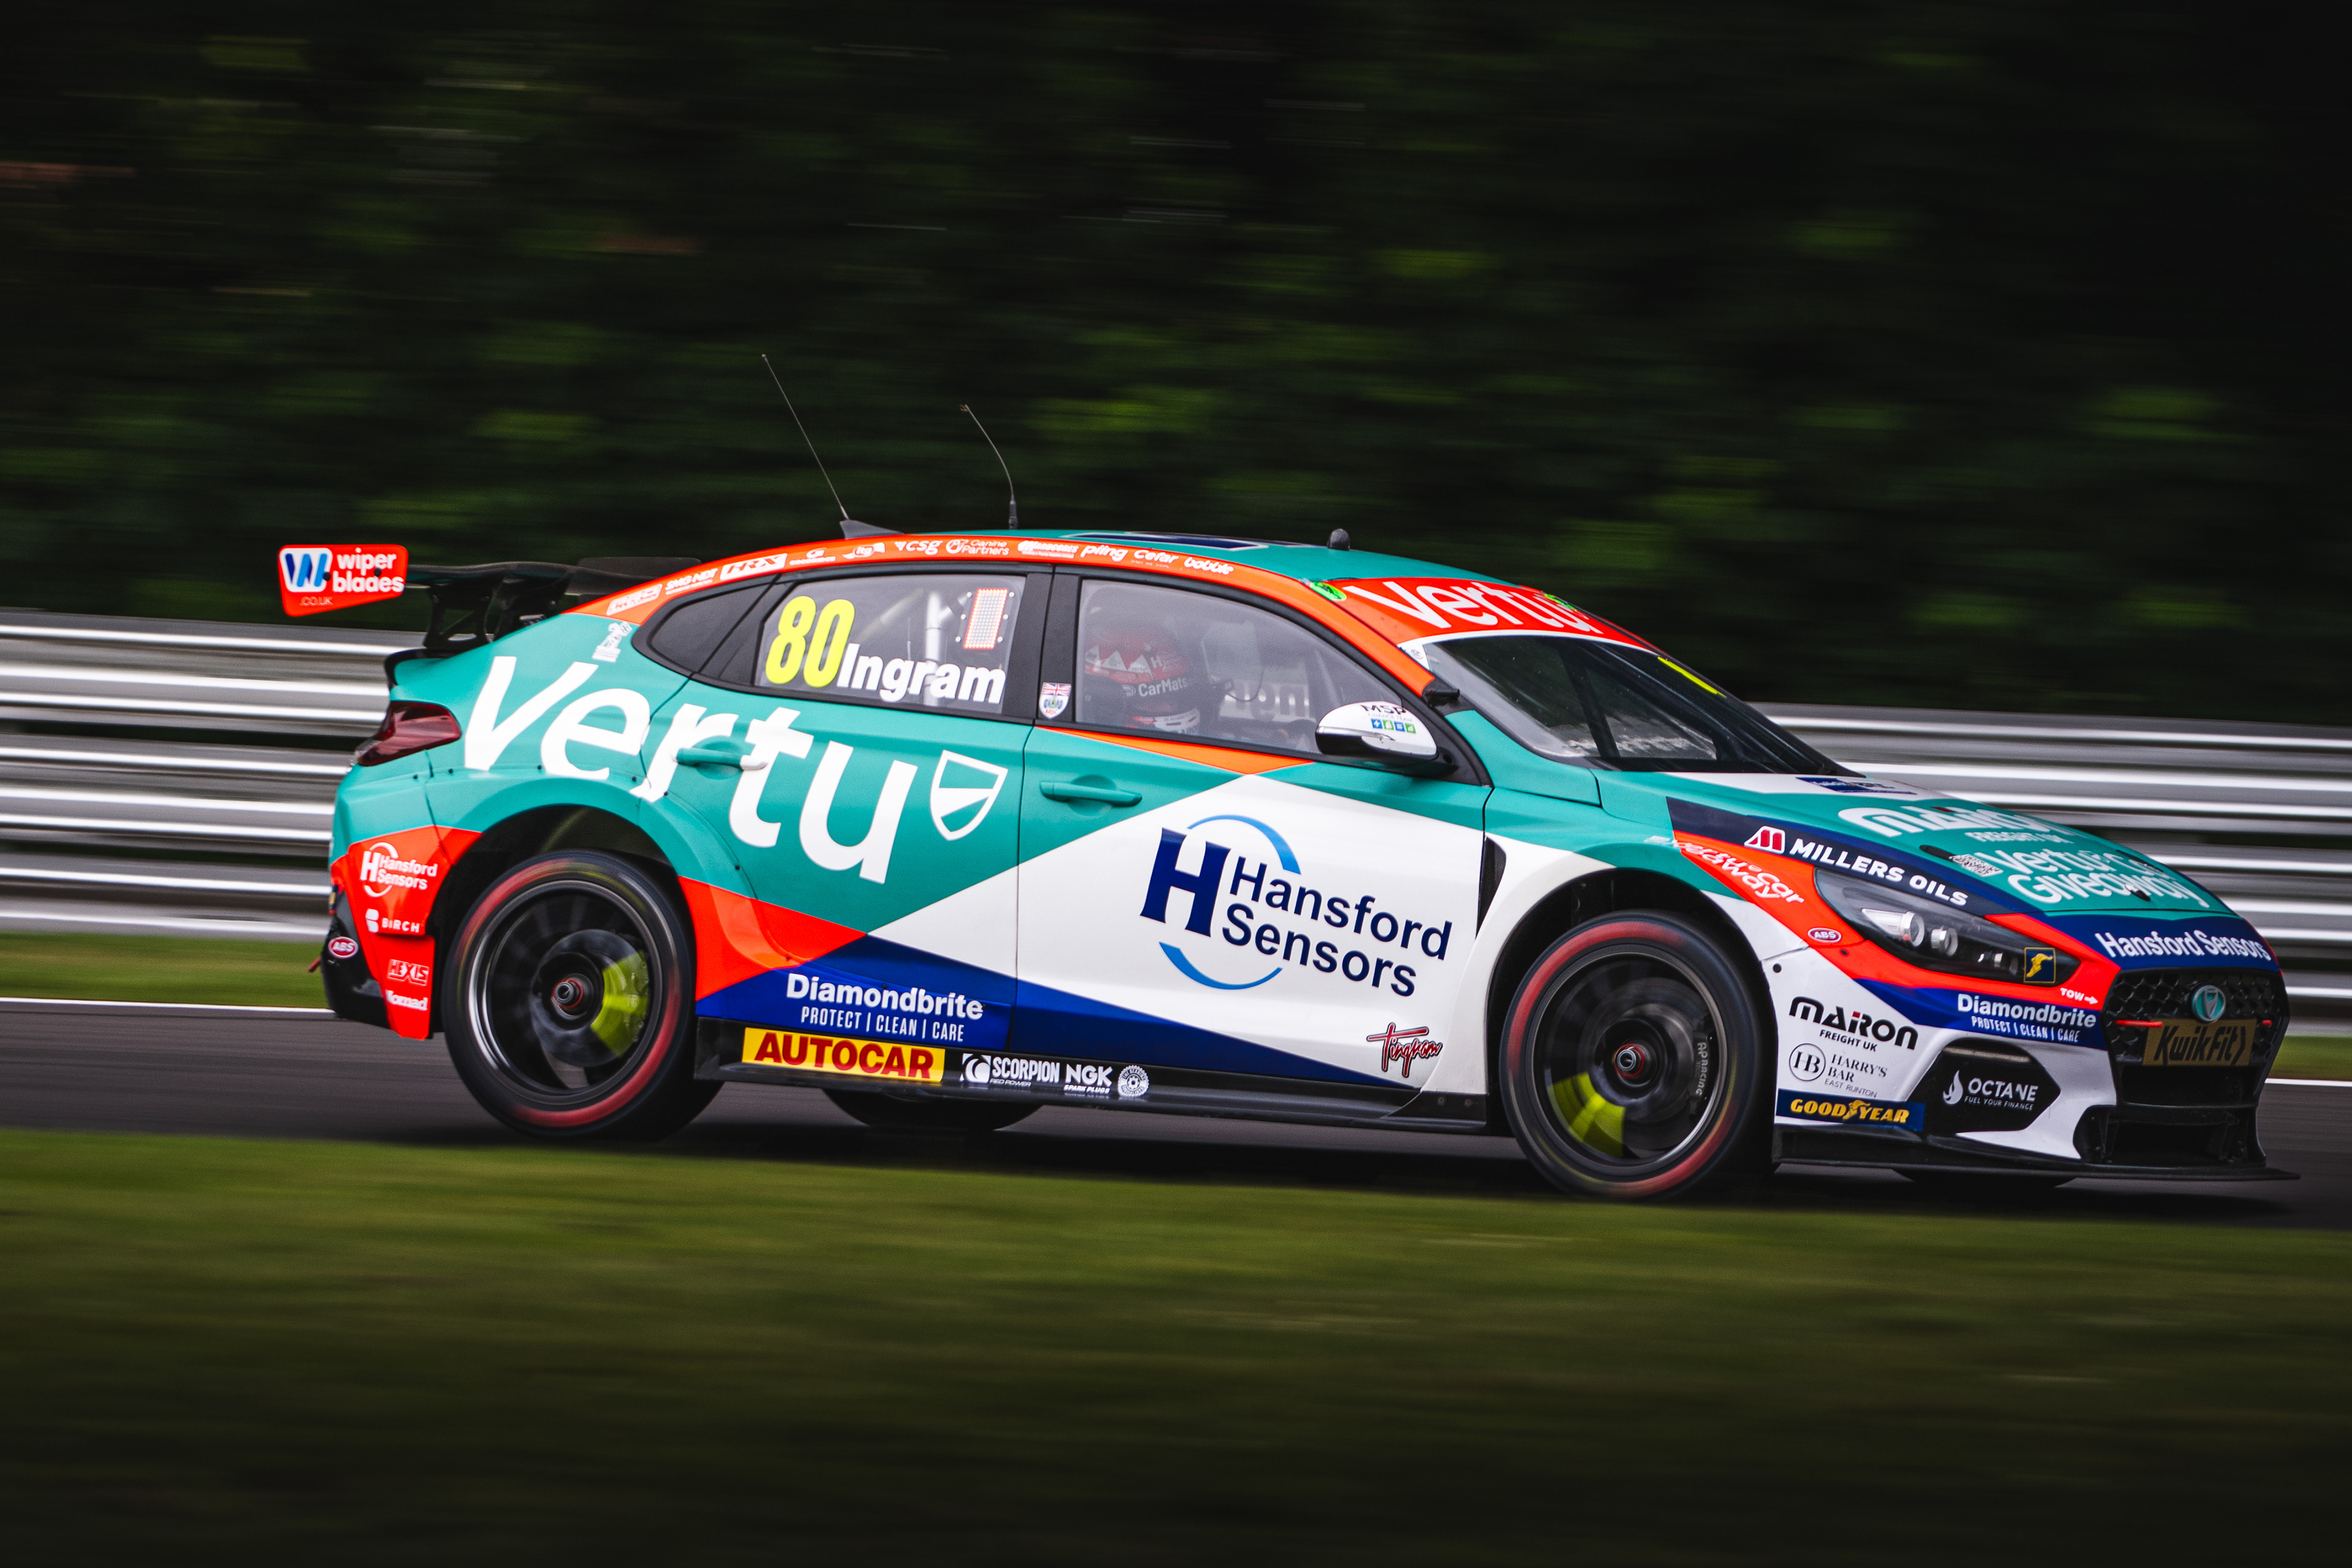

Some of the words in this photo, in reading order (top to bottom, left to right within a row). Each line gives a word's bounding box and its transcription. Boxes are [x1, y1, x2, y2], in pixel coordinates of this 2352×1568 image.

[336, 547, 397, 576] wiper
[962, 545, 1010, 556] Partners
[333, 570, 405, 593] blades
[1343, 581, 1604, 635] Vertu
[765, 595, 855, 687] 80
[837, 643, 1006, 704] Ingram
[1138, 677, 1188, 697] CarMats
[1360, 704, 1407, 715] MSP
[464, 655, 918, 884] Vertu
[380, 855, 438, 877] Hansford
[1789, 838, 1905, 883] MILLERS
[1909, 874, 1969, 907] OILS
[377, 869, 428, 890] Sensors
[1139, 826, 1232, 938] H
[1757, 872, 1804, 903] Car
[1229, 856, 1453, 961] Hansford
[381, 918, 420, 933] BIRCH
[1813, 929, 1836, 940] ABS
[332, 941, 355, 952] ABS
[1222, 903, 1417, 997] Sensors
[2095, 930, 2198, 959] Hansford
[2193, 929, 2272, 962] Sensors
[388, 959, 429, 987] HEXIS
[385, 989, 428, 1011] Nomad
[786, 973, 984, 1020] Diamondbrite
[2060, 987, 2085, 1001] TOW
[1957, 993, 2097, 1028] Diamondbrite
[801, 1006, 862, 1031] PROTECT
[875, 1014, 918, 1038] CLEAN
[932, 1022, 965, 1042] CARE
[1971, 1015, 2011, 1034] PROTECT
[2020, 1024, 2048, 1039] CLEAN
[2057, 1028, 2079, 1042] CARE
[1819, 1029, 1861, 1047] FREIGHT
[1863, 1042, 1878, 1052] UK
[754, 1031, 935, 1080] AUTOCAR
[1831, 1054, 1888, 1077] HARRY'S
[992, 1056, 1060, 1084] SCORPION
[1065, 1063, 1113, 1087] NGK
[1695, 1059, 1708, 1096] RACING
[1827, 1066, 1855, 1083] BAR
[1063, 1084, 1087, 1092] SPARK
[1824, 1078, 1844, 1089] EAST
[1845, 1084, 1878, 1098] RUNTON
[1967, 1077, 2039, 1102] OCTANE
[1984, 1098, 2002, 1106] YOUR
[2003, 1101, 2034, 1111] FINANCE
